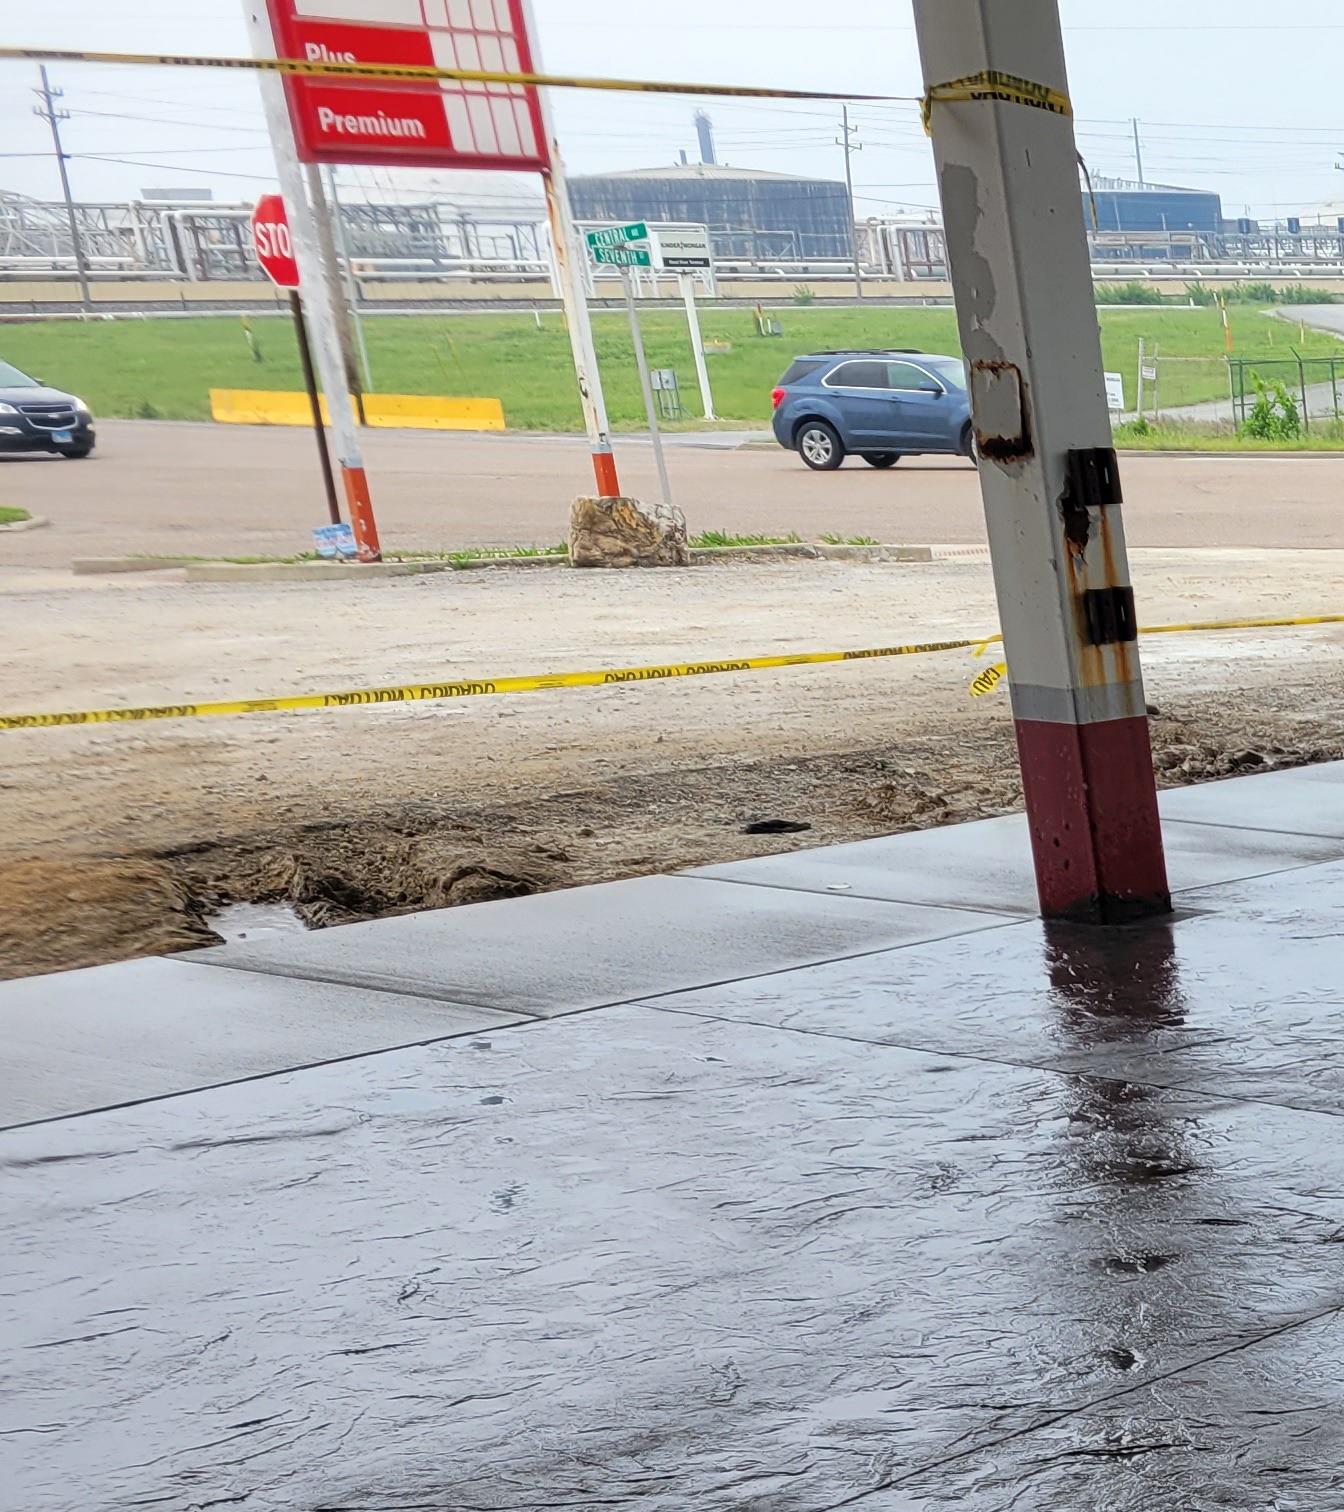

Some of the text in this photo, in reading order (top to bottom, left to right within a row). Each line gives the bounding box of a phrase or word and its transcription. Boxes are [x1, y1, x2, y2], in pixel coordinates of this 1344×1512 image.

[305, 42, 356, 64] Plus
[318, 106, 426, 139] Premium
[256, 222, 294, 258] STO
[594, 227, 629, 247] CENTRAL
[599, 249, 637, 264] SEVENTH
